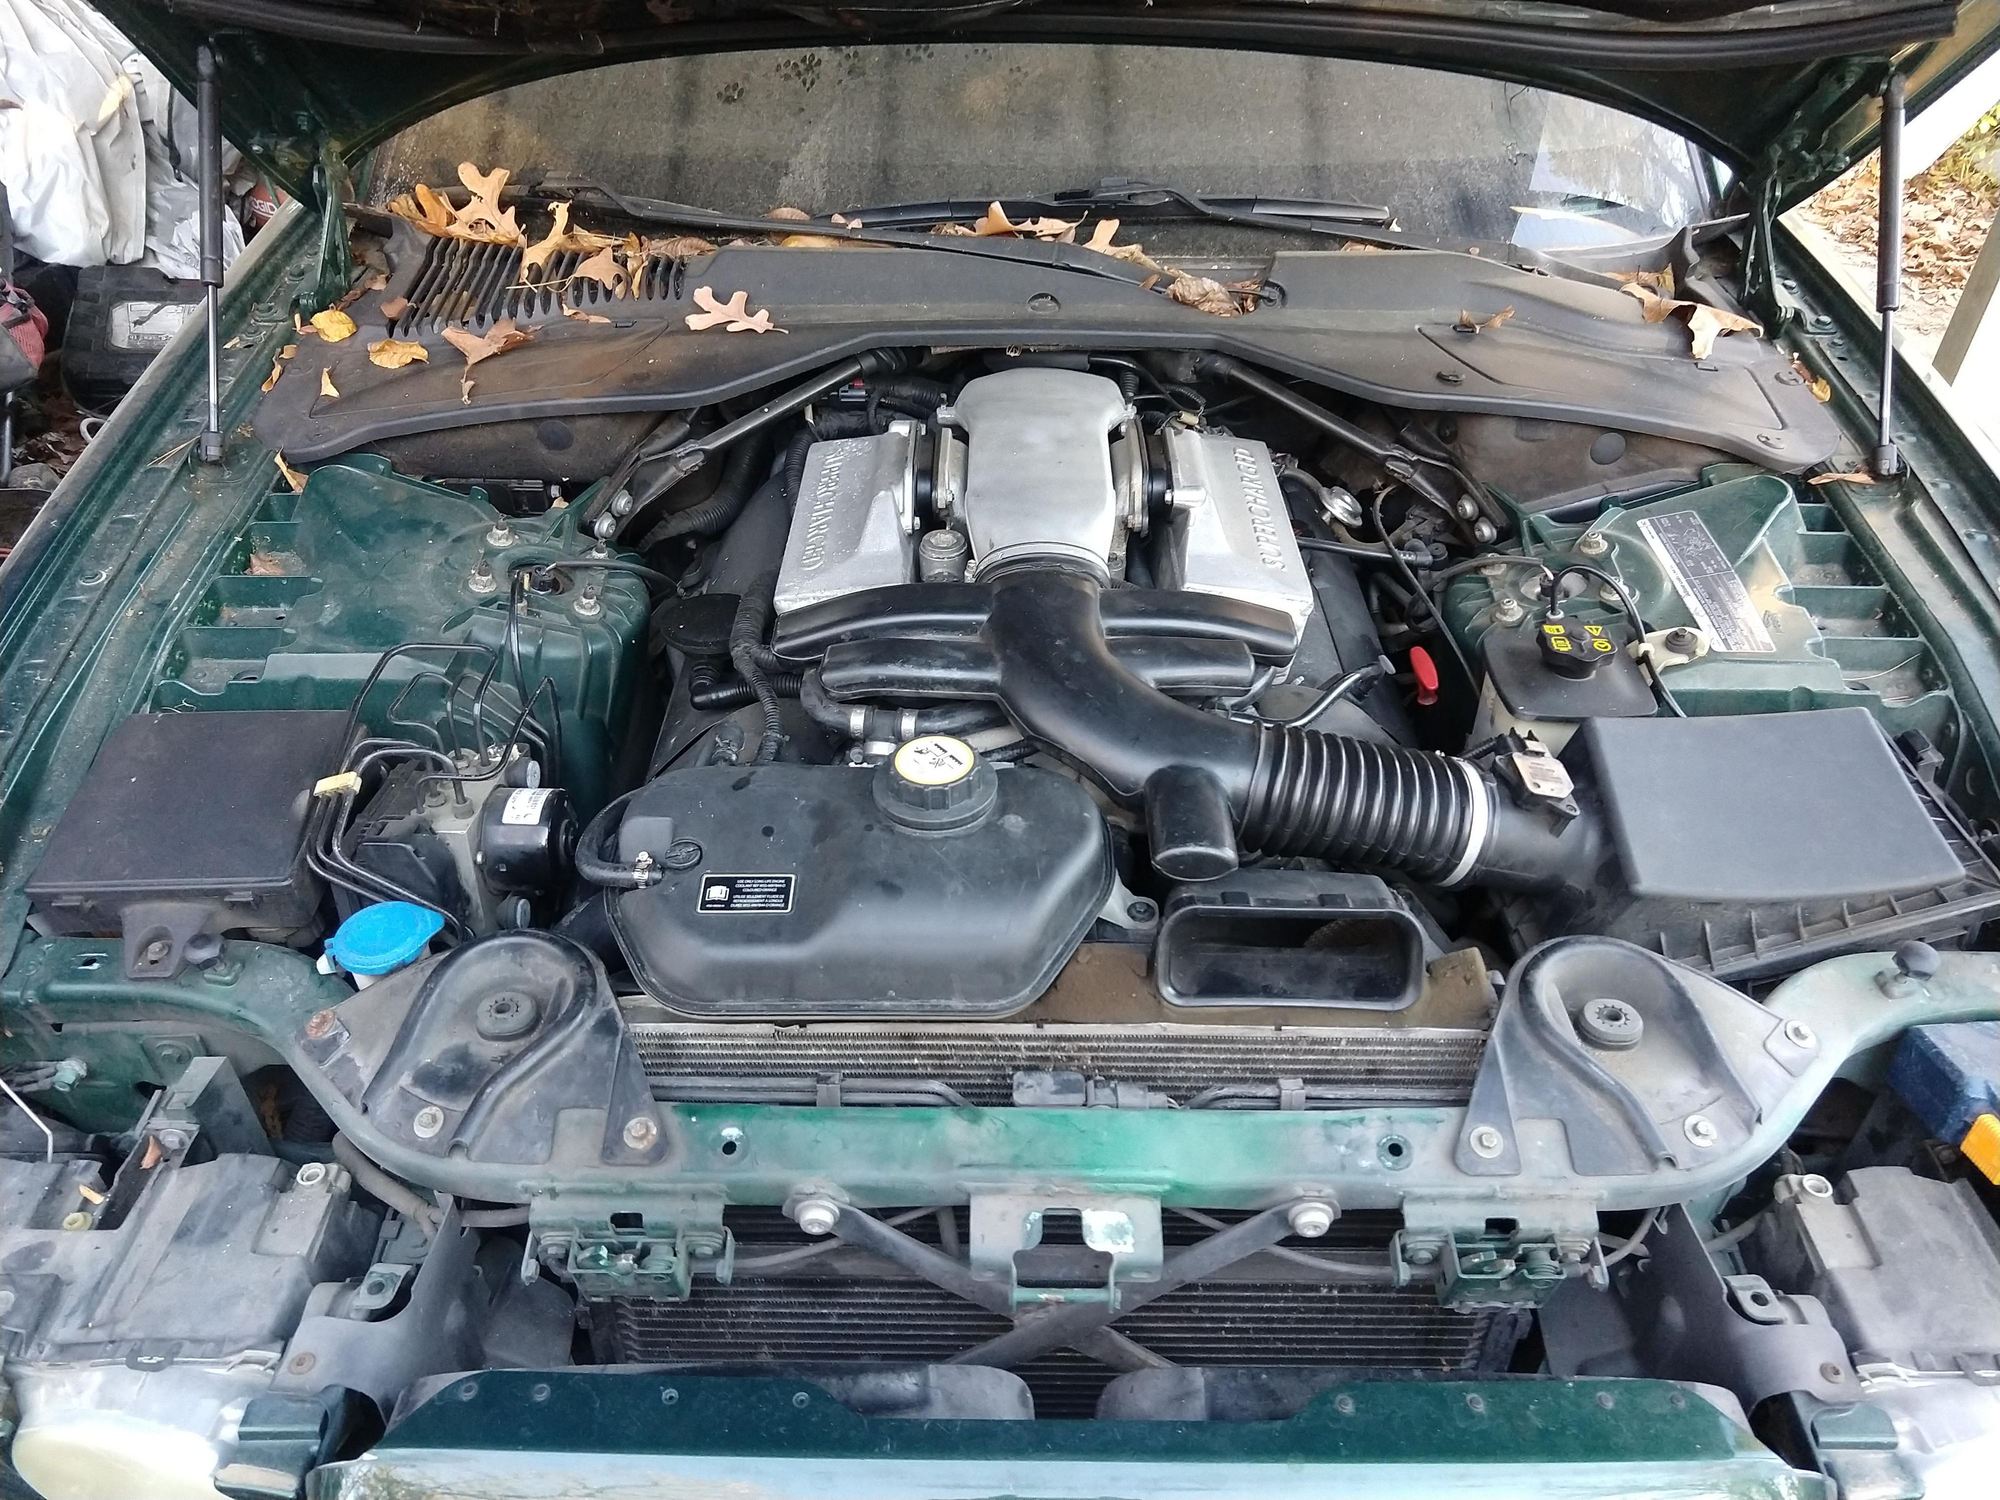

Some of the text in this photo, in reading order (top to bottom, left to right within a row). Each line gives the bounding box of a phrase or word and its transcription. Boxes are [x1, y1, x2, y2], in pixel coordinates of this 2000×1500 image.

[252, 198, 277, 214] DGID
[800, 448, 844, 571] SUPERCHARGED
[1233, 447, 1288, 572] SUPERCHARGED
